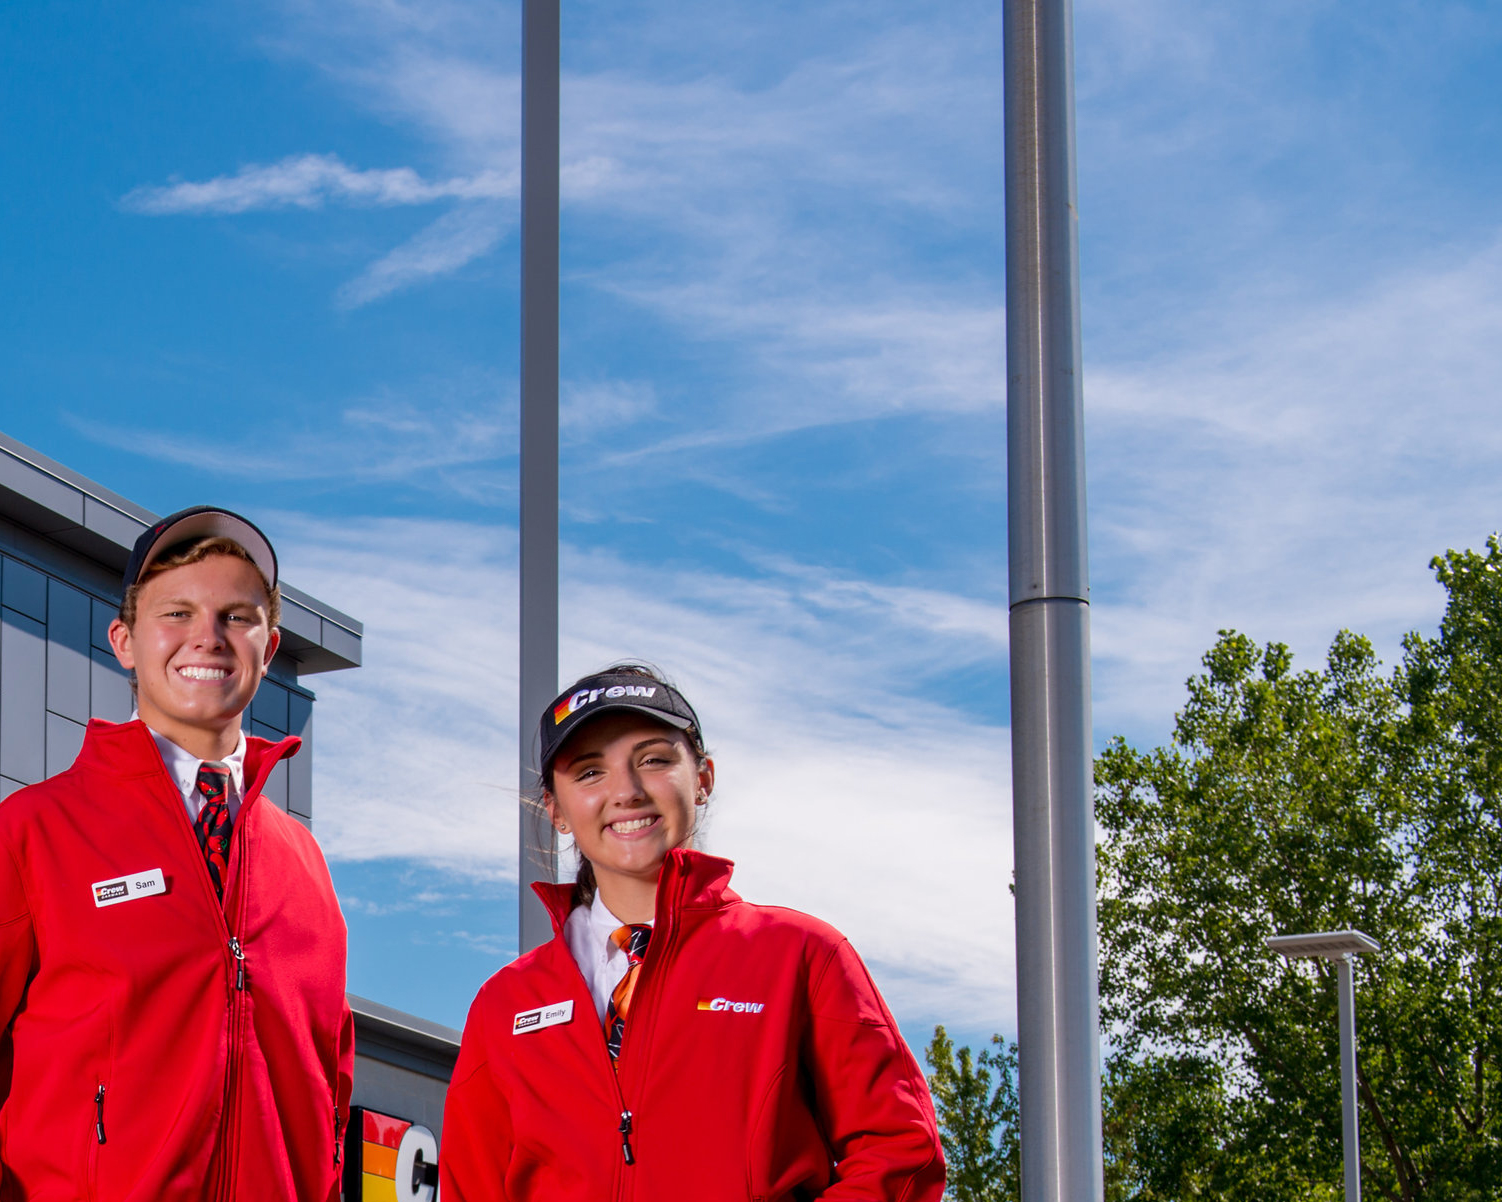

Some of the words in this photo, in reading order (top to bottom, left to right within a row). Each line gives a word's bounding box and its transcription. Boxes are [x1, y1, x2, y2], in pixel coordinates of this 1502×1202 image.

[568, 685, 656, 712] Crew
[135, 880, 156, 889] Sam
[100, 885, 125, 896] Crew
[709, 997, 765, 1013] Crew
[545, 1009, 566, 1019] Emily
